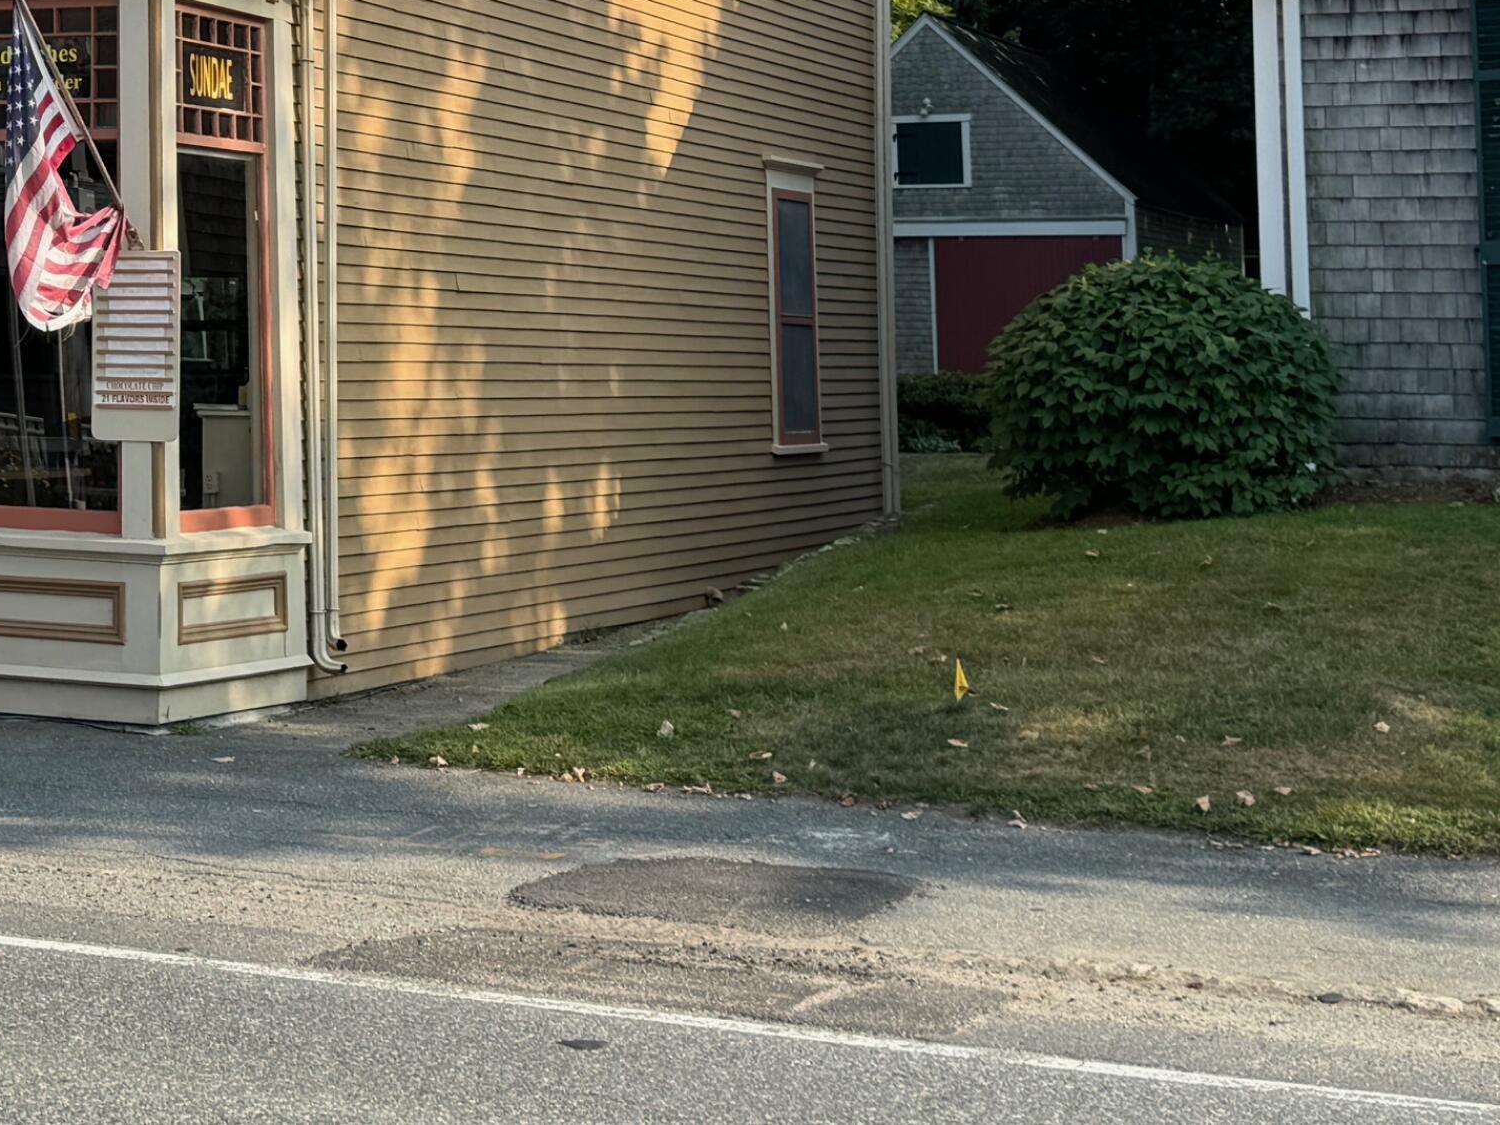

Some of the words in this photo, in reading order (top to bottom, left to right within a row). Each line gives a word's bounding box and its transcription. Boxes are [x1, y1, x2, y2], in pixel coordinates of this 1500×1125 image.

[189, 52, 234, 100] SUNDAE
[112, 394, 145, 403] FLAVORS
[146, 395, 170, 404] INSIDE
